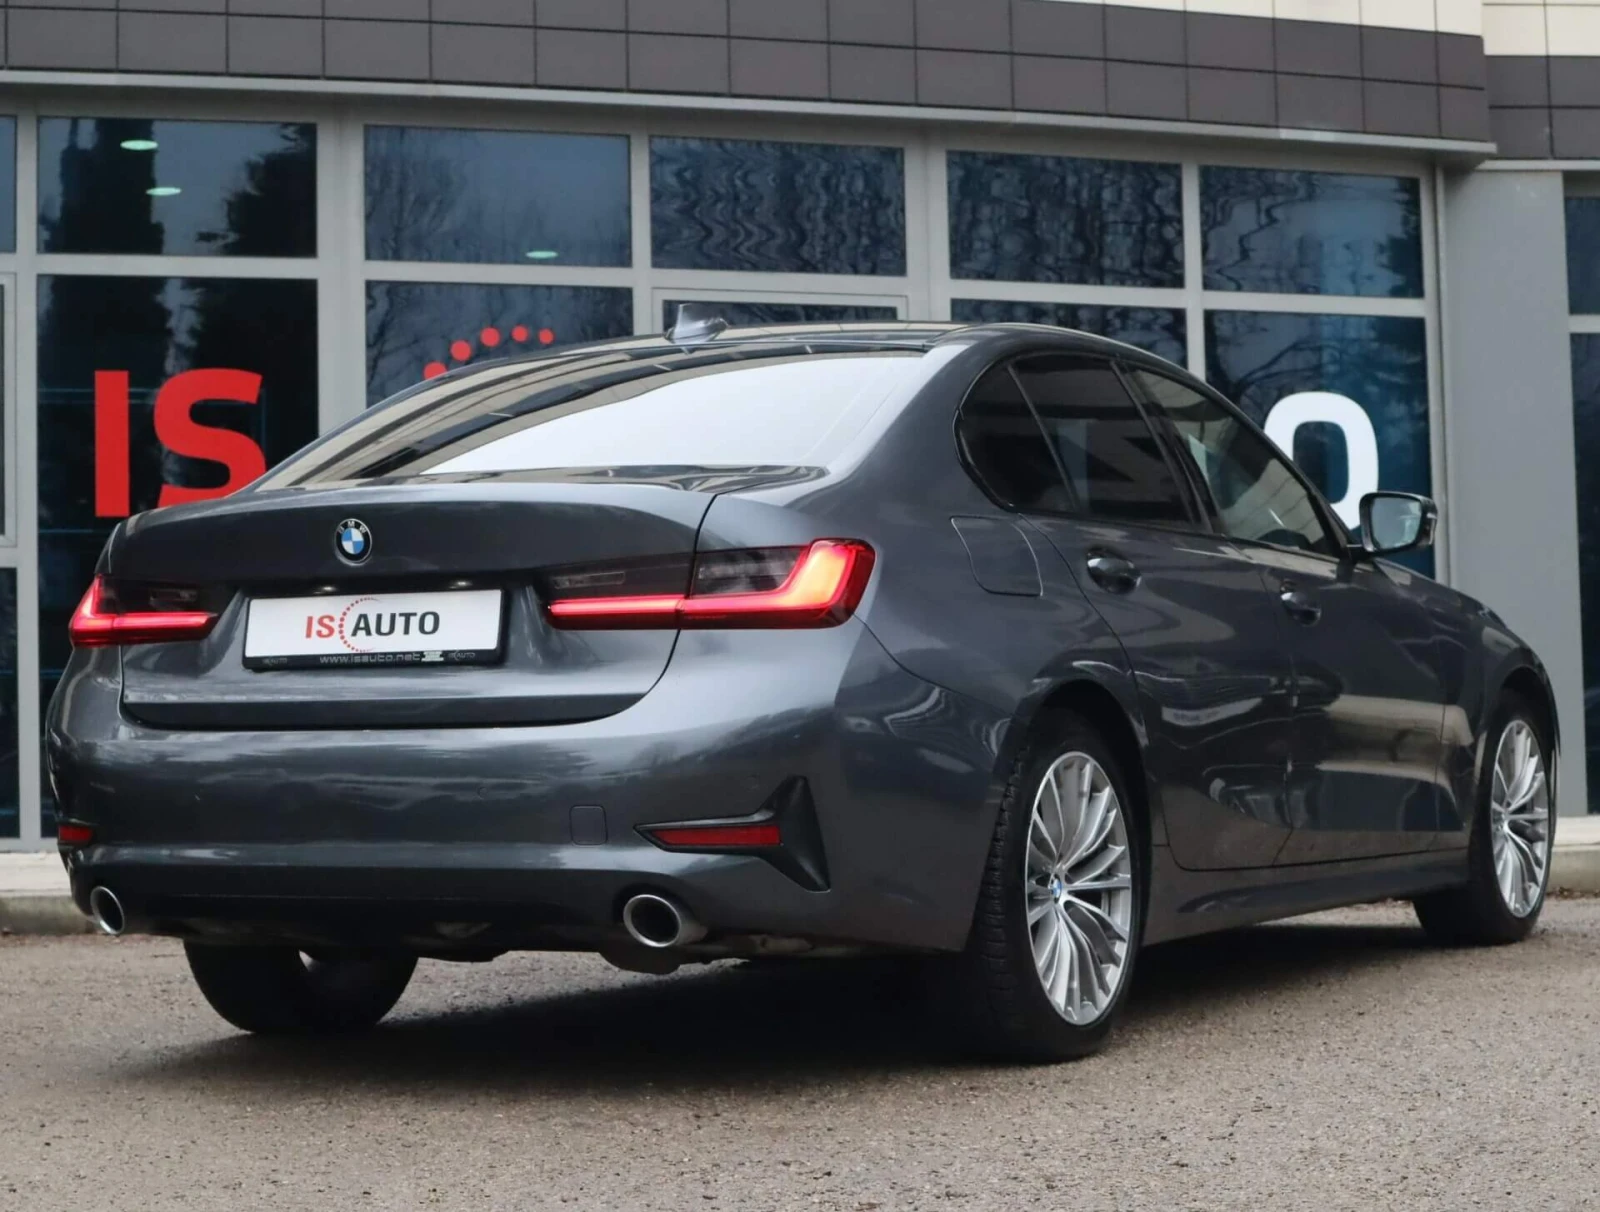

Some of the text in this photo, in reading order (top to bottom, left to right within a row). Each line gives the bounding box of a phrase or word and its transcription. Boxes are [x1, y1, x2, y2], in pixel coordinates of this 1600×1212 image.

[94, 368, 266, 516] IS
[305, 611, 440, 639] IS AUTO
[319, 652, 421, 664] www.isauto.net
